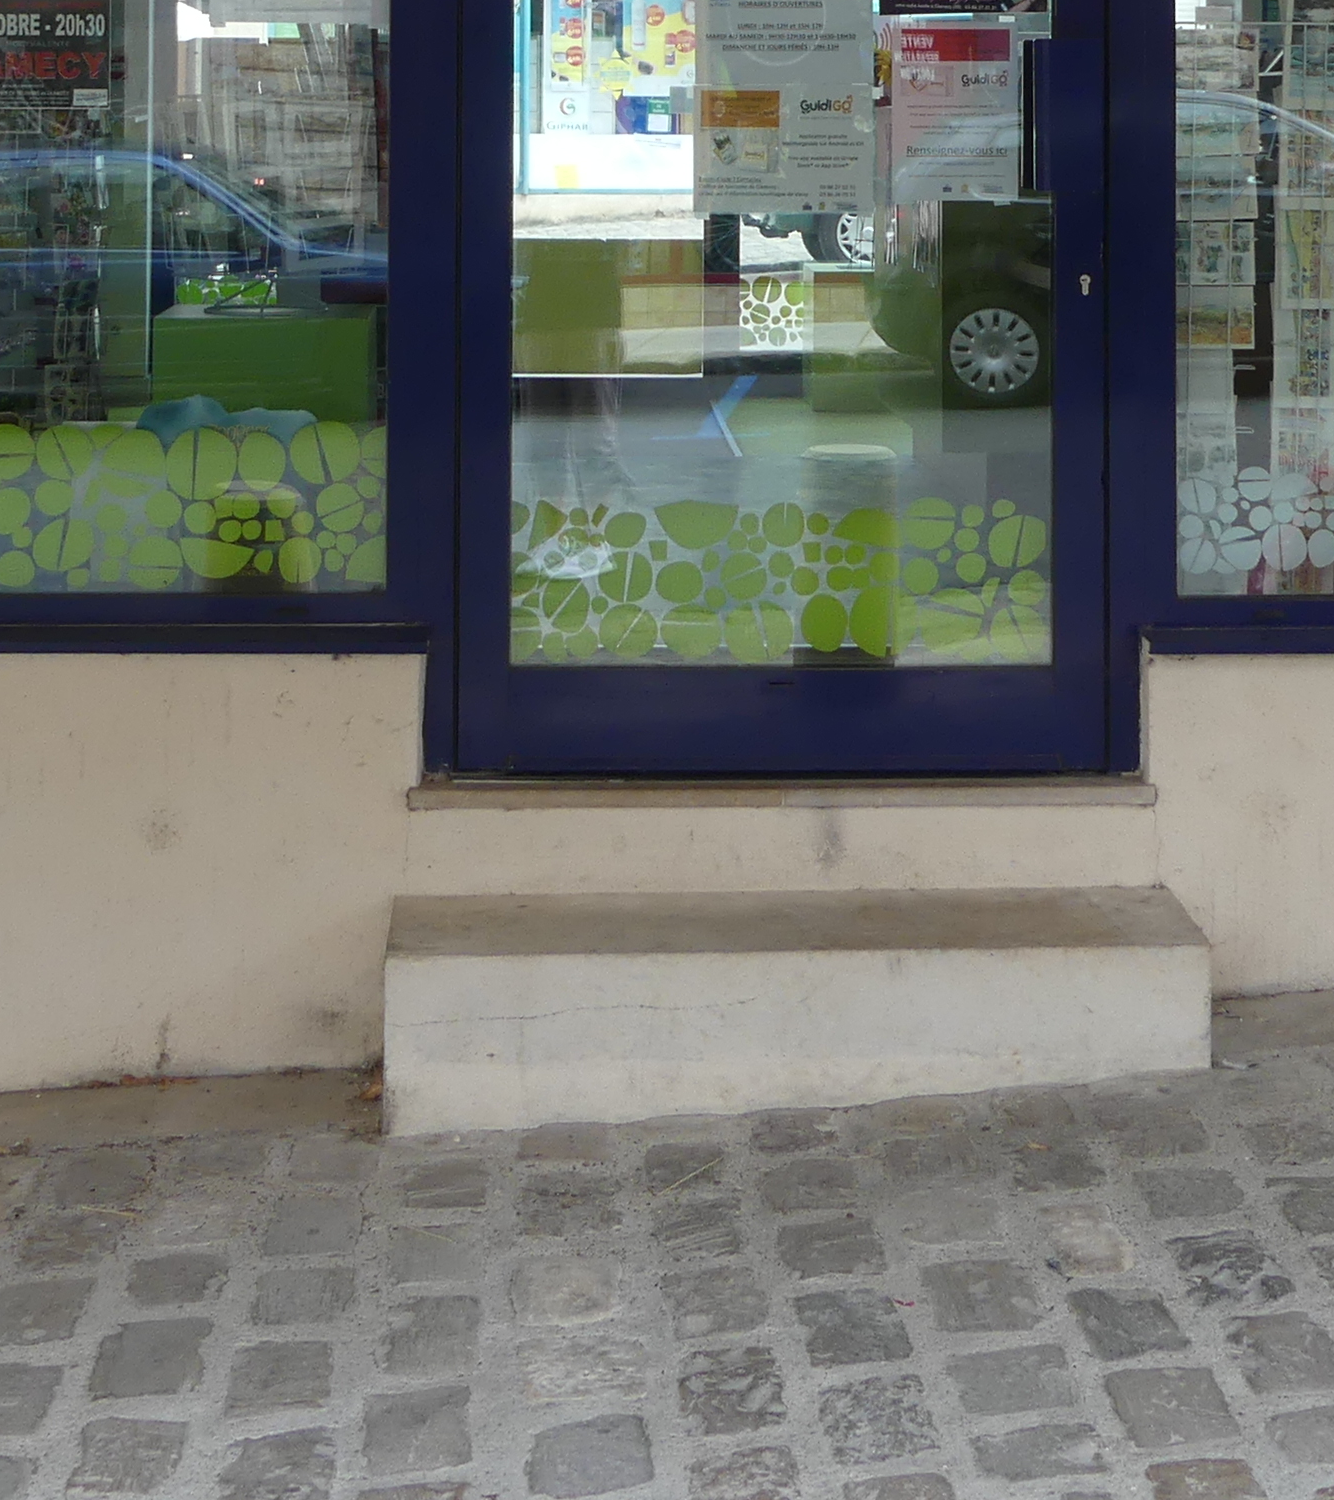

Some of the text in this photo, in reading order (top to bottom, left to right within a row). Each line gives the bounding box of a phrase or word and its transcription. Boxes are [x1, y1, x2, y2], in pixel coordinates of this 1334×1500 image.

[54, 13, 106, 36] 20h30
[722, 43, 757, 51] DIMANCHE
[906, 144, 994, 156] Renseignez-vous
